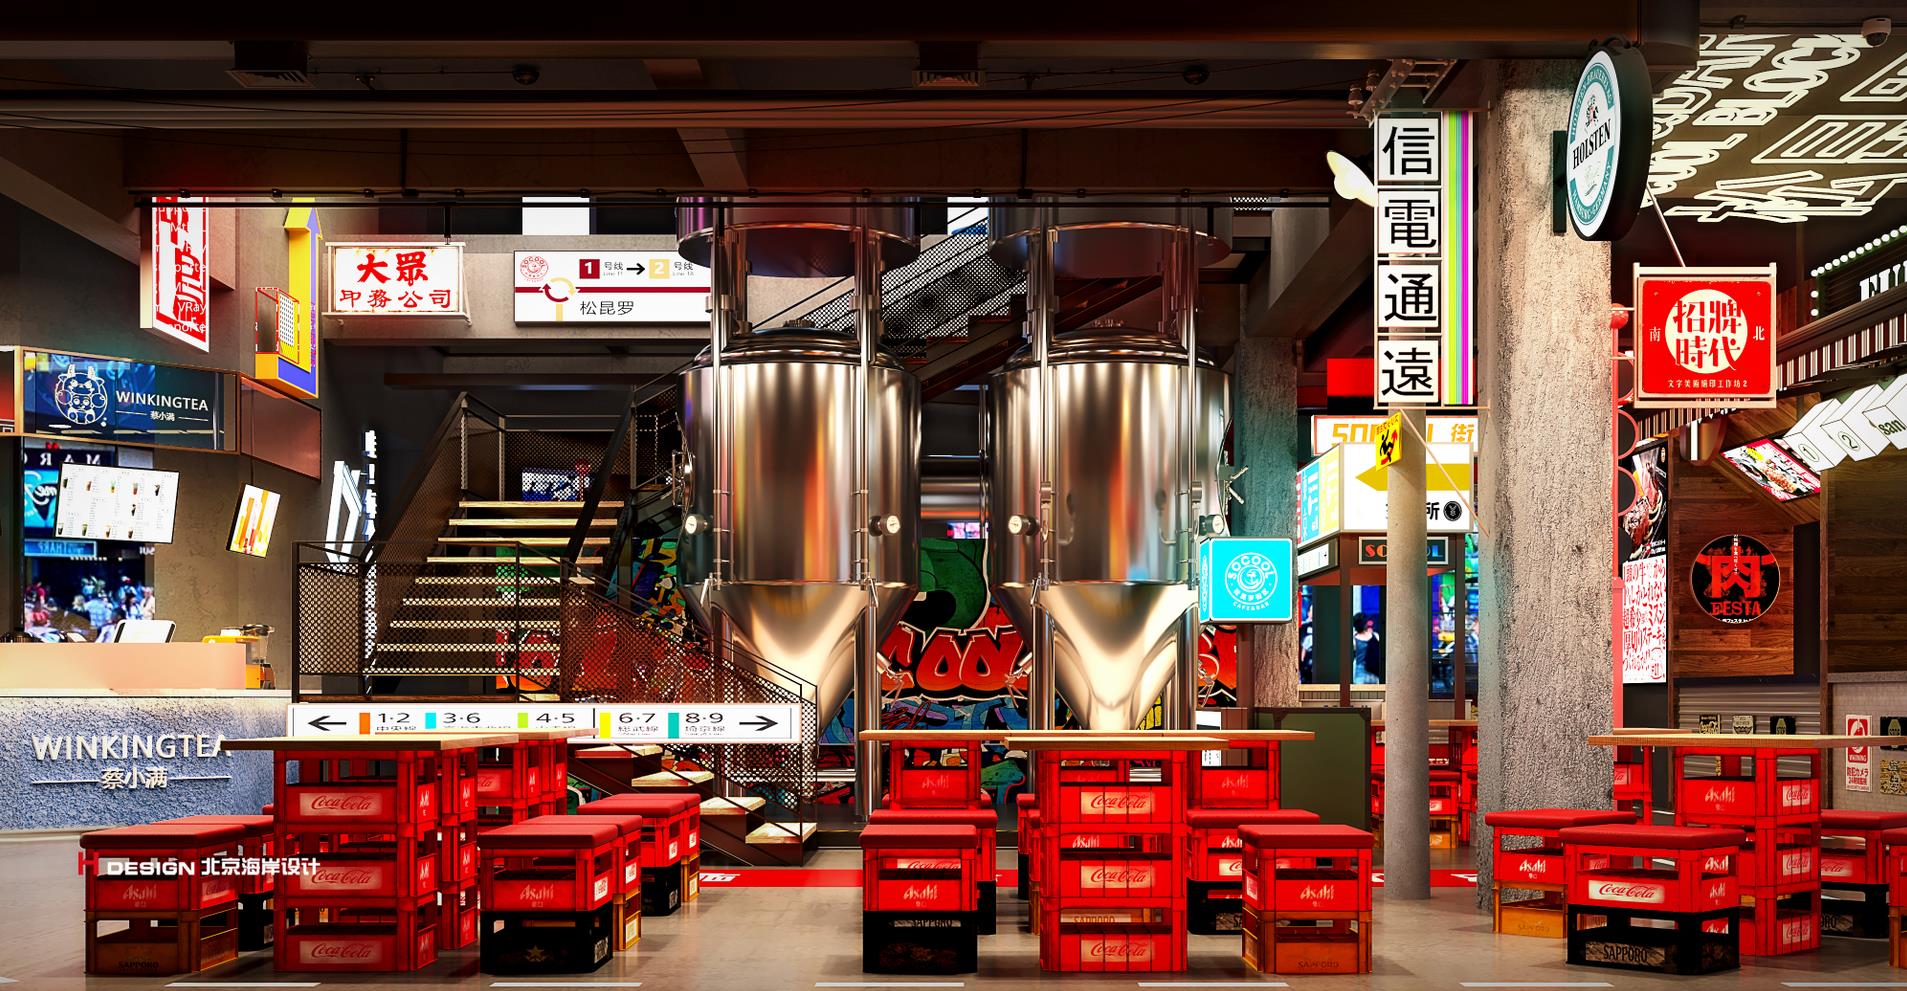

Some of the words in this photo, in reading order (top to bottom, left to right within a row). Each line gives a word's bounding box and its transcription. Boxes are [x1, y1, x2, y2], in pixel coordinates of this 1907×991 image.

[1572, 119, 1612, 170] HOLSTEN
[584, 261, 593, 275] 1
[604, 262, 624, 272] 号线
[654, 261, 665, 275] 2
[673, 262, 694, 272] 号线
[1379, 125, 1438, 398] 信電通遠
[339, 289, 452, 309] 印務公司
[579, 301, 634, 316] 松昆罗
[1649, 326, 1661, 342] 南
[1753, 325, 1766, 341] 北
[115, 390, 209, 412] WINKINGTEA
[150, 411, 176, 422] 蔡小满
[1878, 420, 1906, 436] san
[1227, 555, 1276, 580] SOCOOL
[1711, 545, 1761, 598] 肉
[101, 767, 168, 790] 蔡小满
[1090, 794, 1147, 809] Coca-Cola
[1704, 786, 1736, 803] Asahi
[311, 795, 372, 811] Coca-Cola
[1519, 859, 1547, 873] Asahi
[1090, 868, 1147, 883] Coca-Cola
[519, 884, 555, 900] Asahi
[903, 883, 938, 900] Asahi
[1300, 884, 1335, 900] Asahi
[1598, 883, 1656, 899] Coca-Cola
[311, 943, 372, 959] Coca-Cola
[1090, 942, 1147, 957] Coca-Cola
[1603, 944, 1649, 963] SAPPORO
